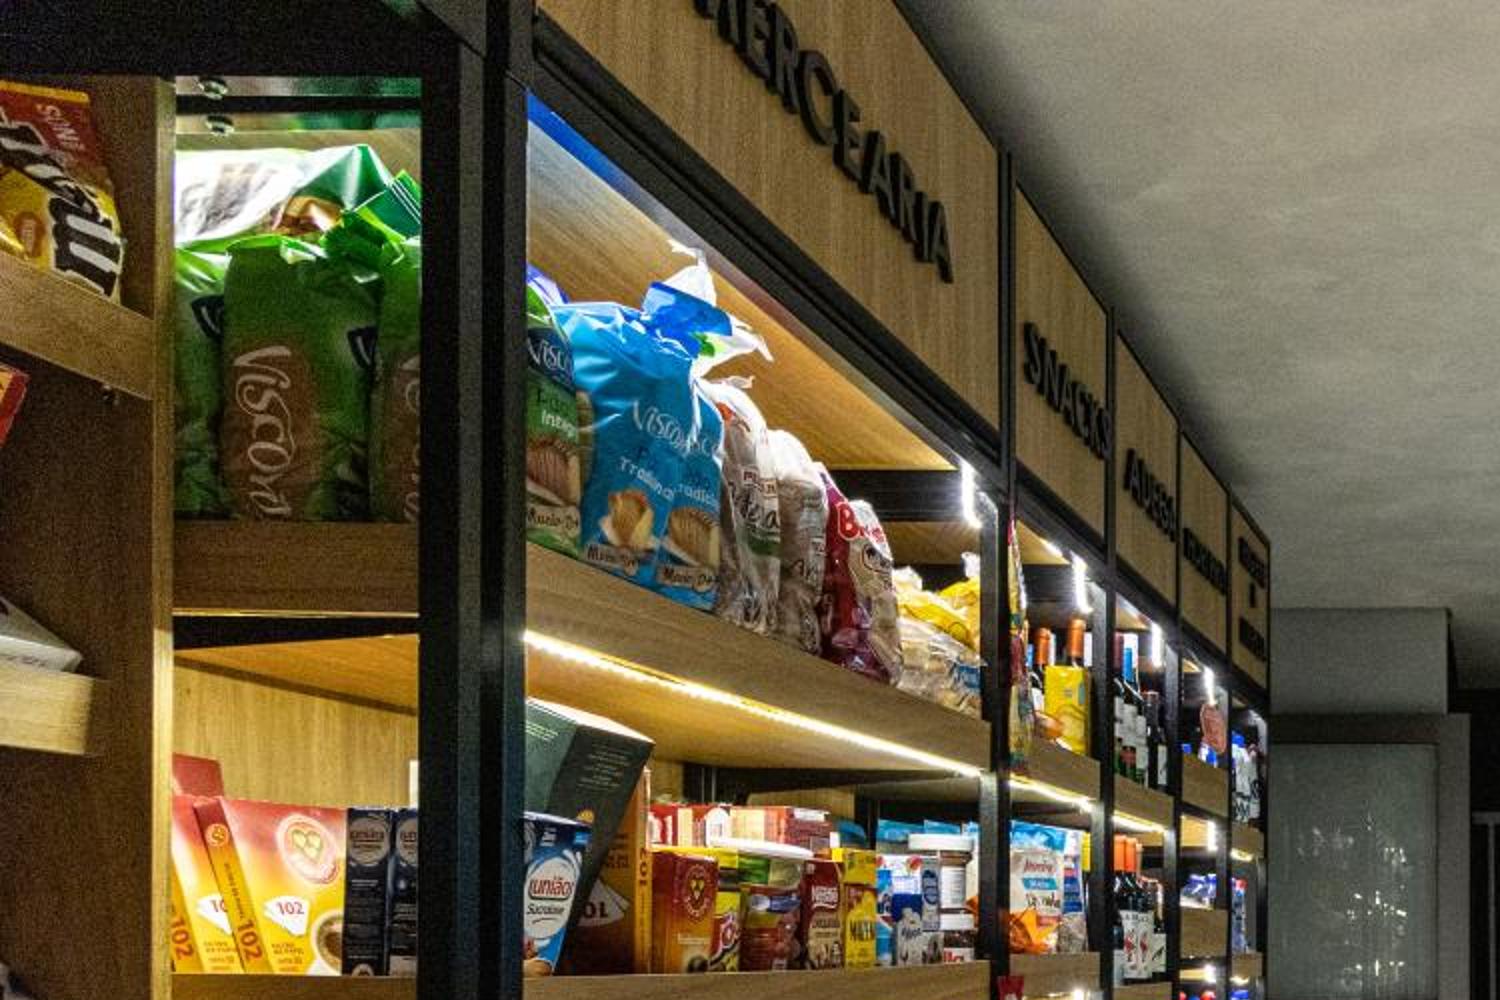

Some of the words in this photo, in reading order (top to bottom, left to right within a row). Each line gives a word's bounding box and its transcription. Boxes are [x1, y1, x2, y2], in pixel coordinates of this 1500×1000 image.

[276, 901, 305, 916] 102
[171, 916, 194, 960] 102
[237, 919, 264, 961] 102
